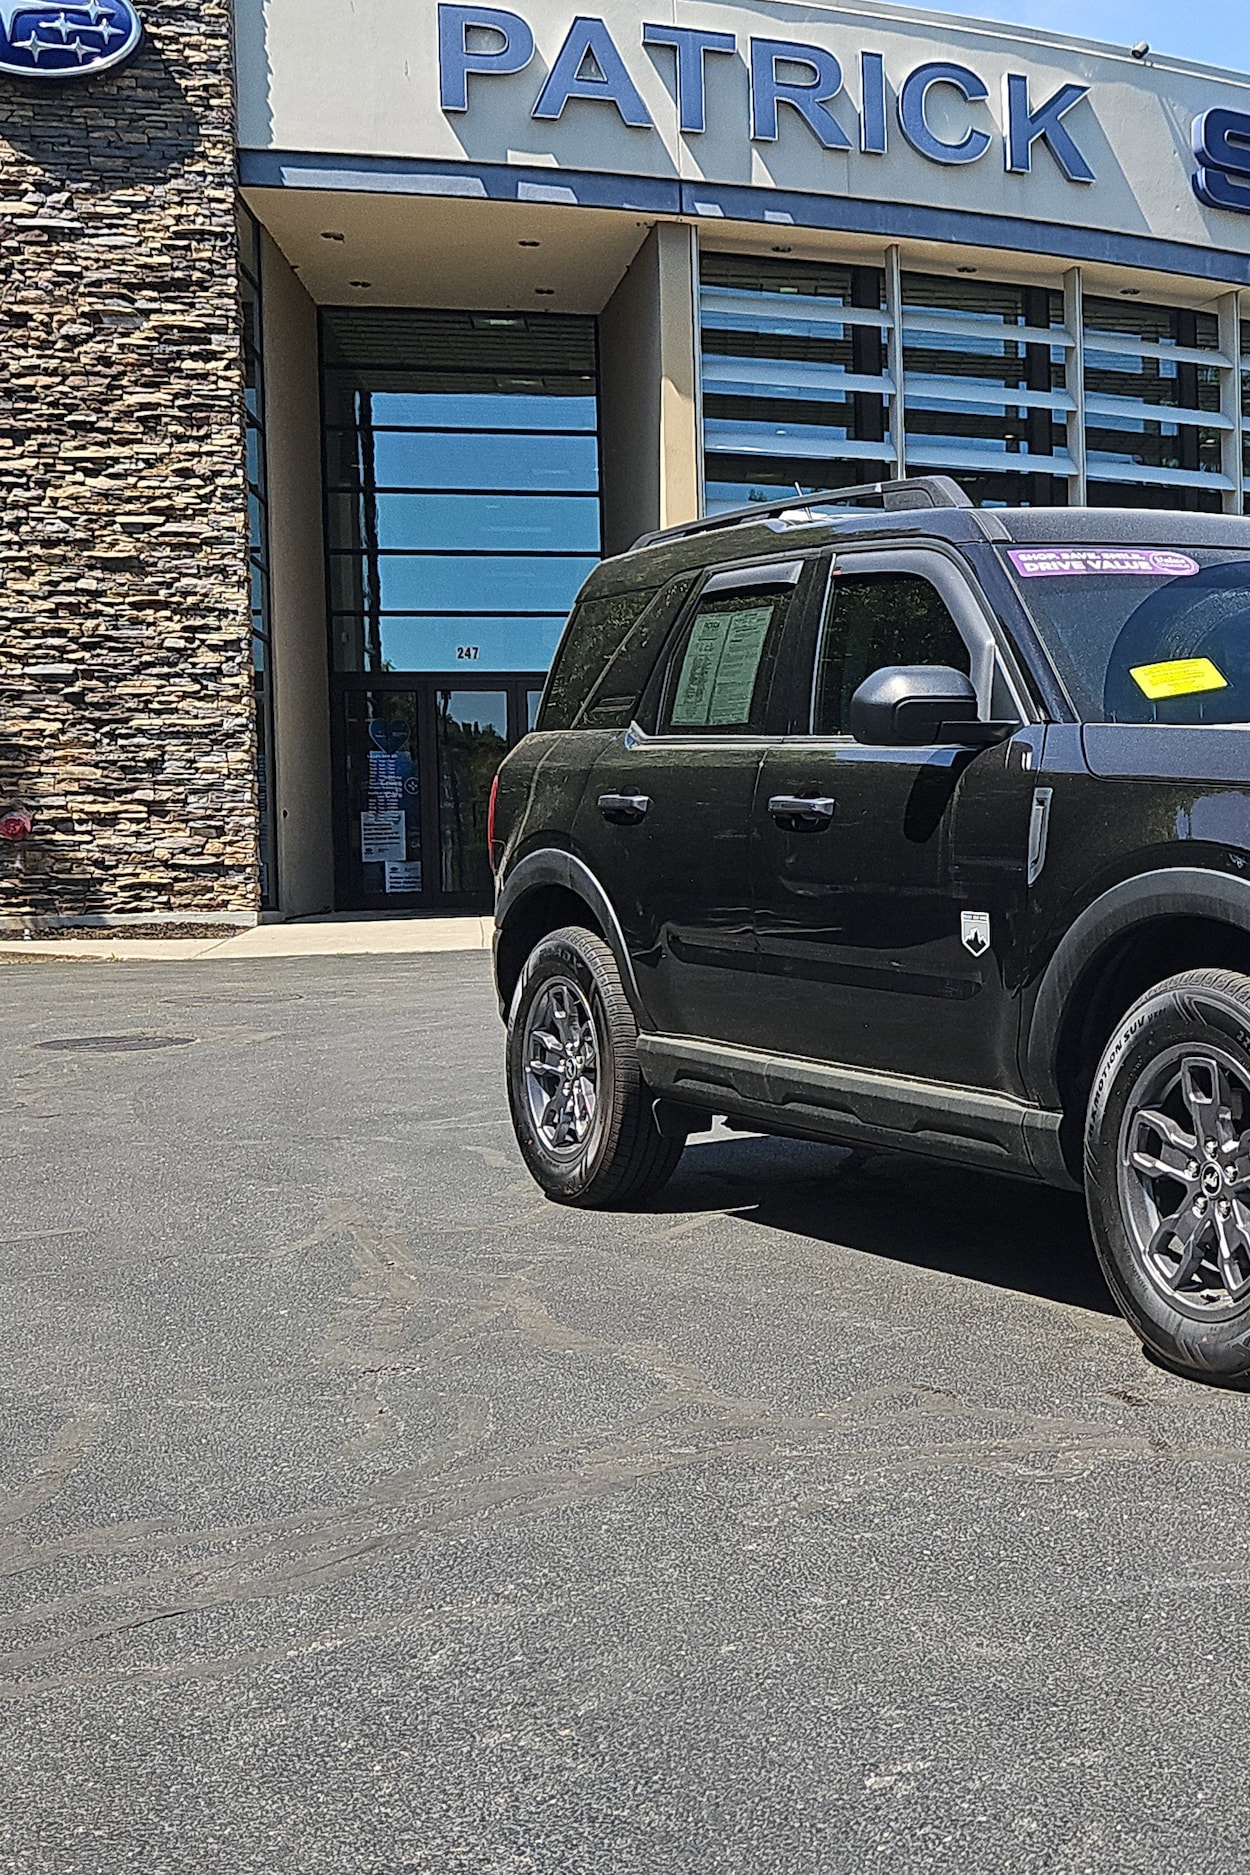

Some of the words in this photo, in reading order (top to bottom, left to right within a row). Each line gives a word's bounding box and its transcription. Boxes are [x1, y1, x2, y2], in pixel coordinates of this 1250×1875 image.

[437, 2, 1096, 184] PATRICK
[1023, 560, 1086, 572] DRIVE
[1086, 560, 1153, 570] VALUE
[457, 646, 479, 660] 247
[1123, 1015, 1147, 1043] SUV
